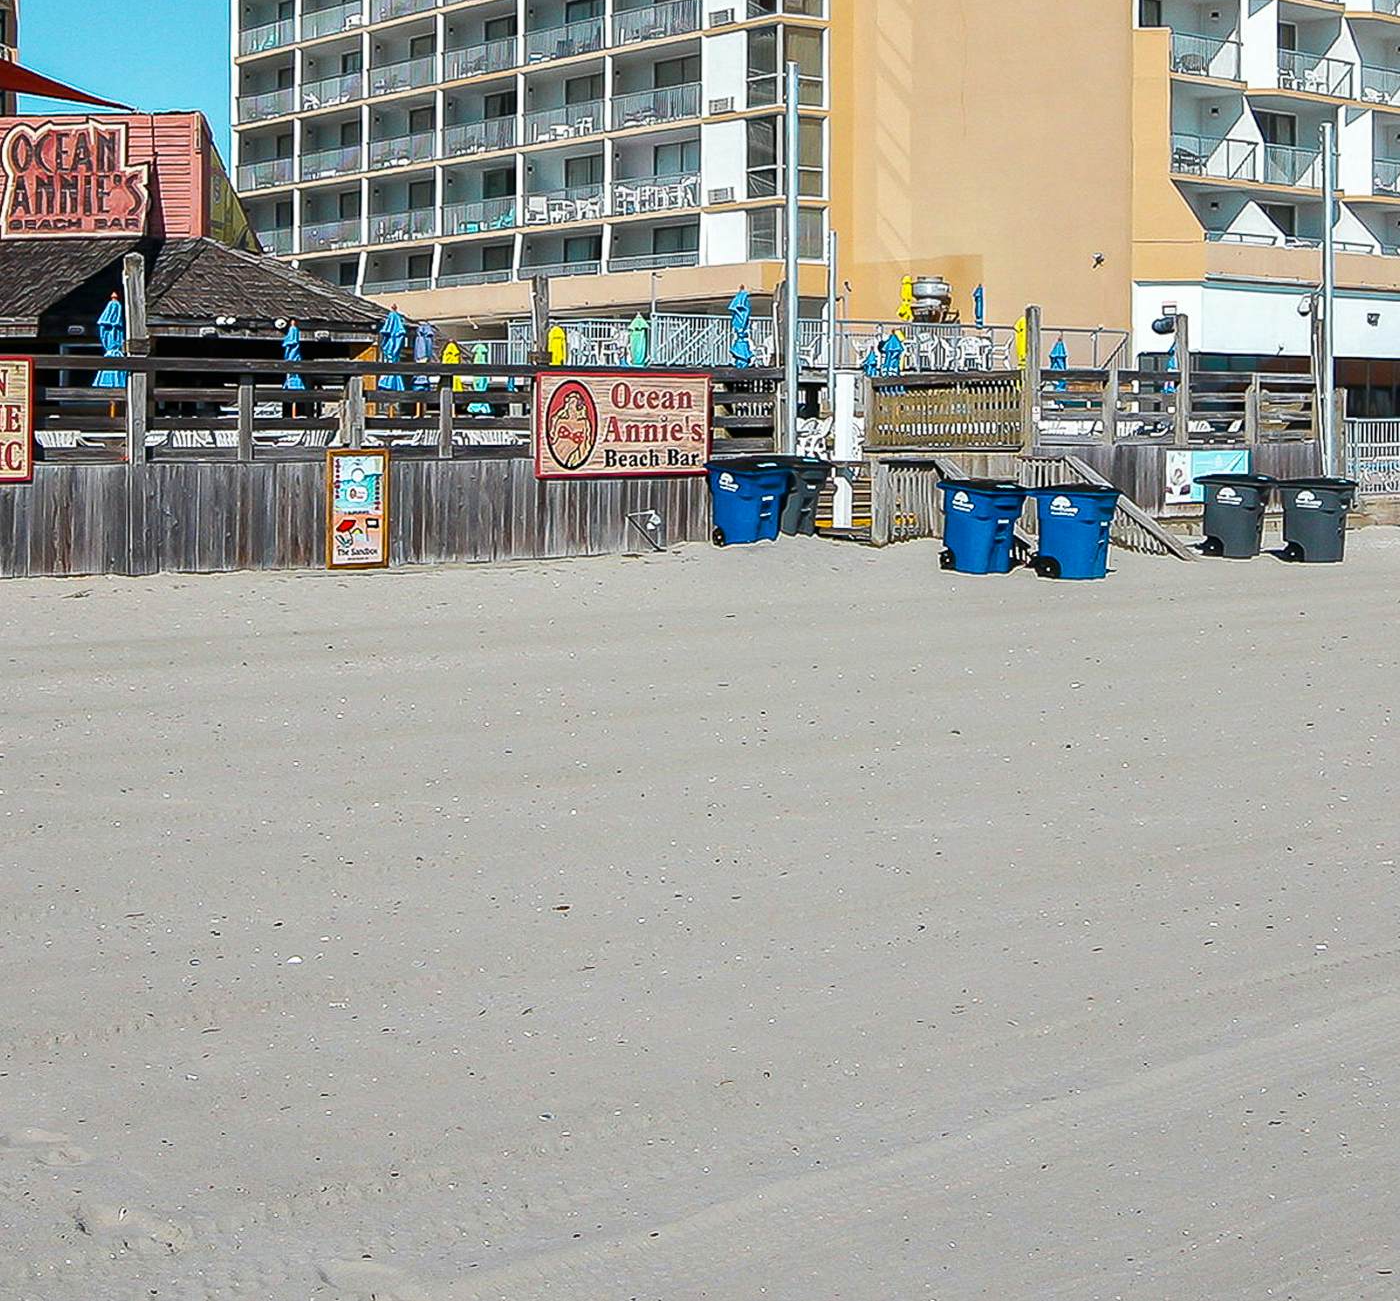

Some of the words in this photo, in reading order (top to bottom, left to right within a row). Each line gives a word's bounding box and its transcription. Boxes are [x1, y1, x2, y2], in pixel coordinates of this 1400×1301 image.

[11, 132, 117, 173] OCEAN
[11, 173, 142, 216] ANNIE'S
[9, 218, 82, 230] BEACH
[95, 218, 140, 230] BAR
[611, 382, 694, 409] Ocean
[603, 416, 705, 443] Annie's
[604, 450, 660, 468] Beach
[667, 449, 700, 466] Bar
